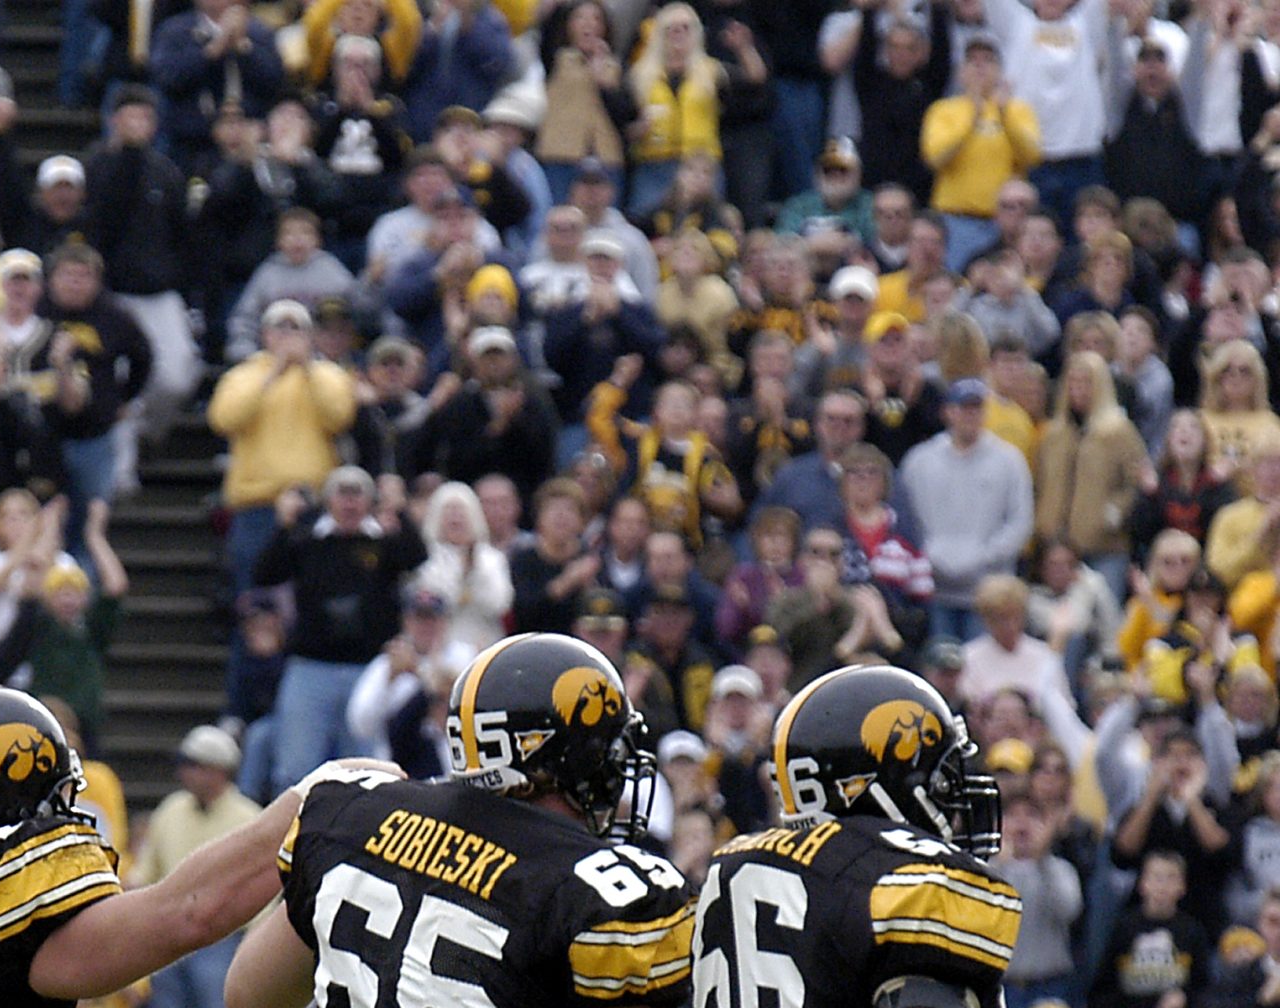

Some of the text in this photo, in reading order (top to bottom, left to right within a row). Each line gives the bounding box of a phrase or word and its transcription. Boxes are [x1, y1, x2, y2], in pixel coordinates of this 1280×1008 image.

[447, 711, 513, 770] 65
[364, 808, 518, 900] SOBIESKI
[573, 844, 686, 908] 65
